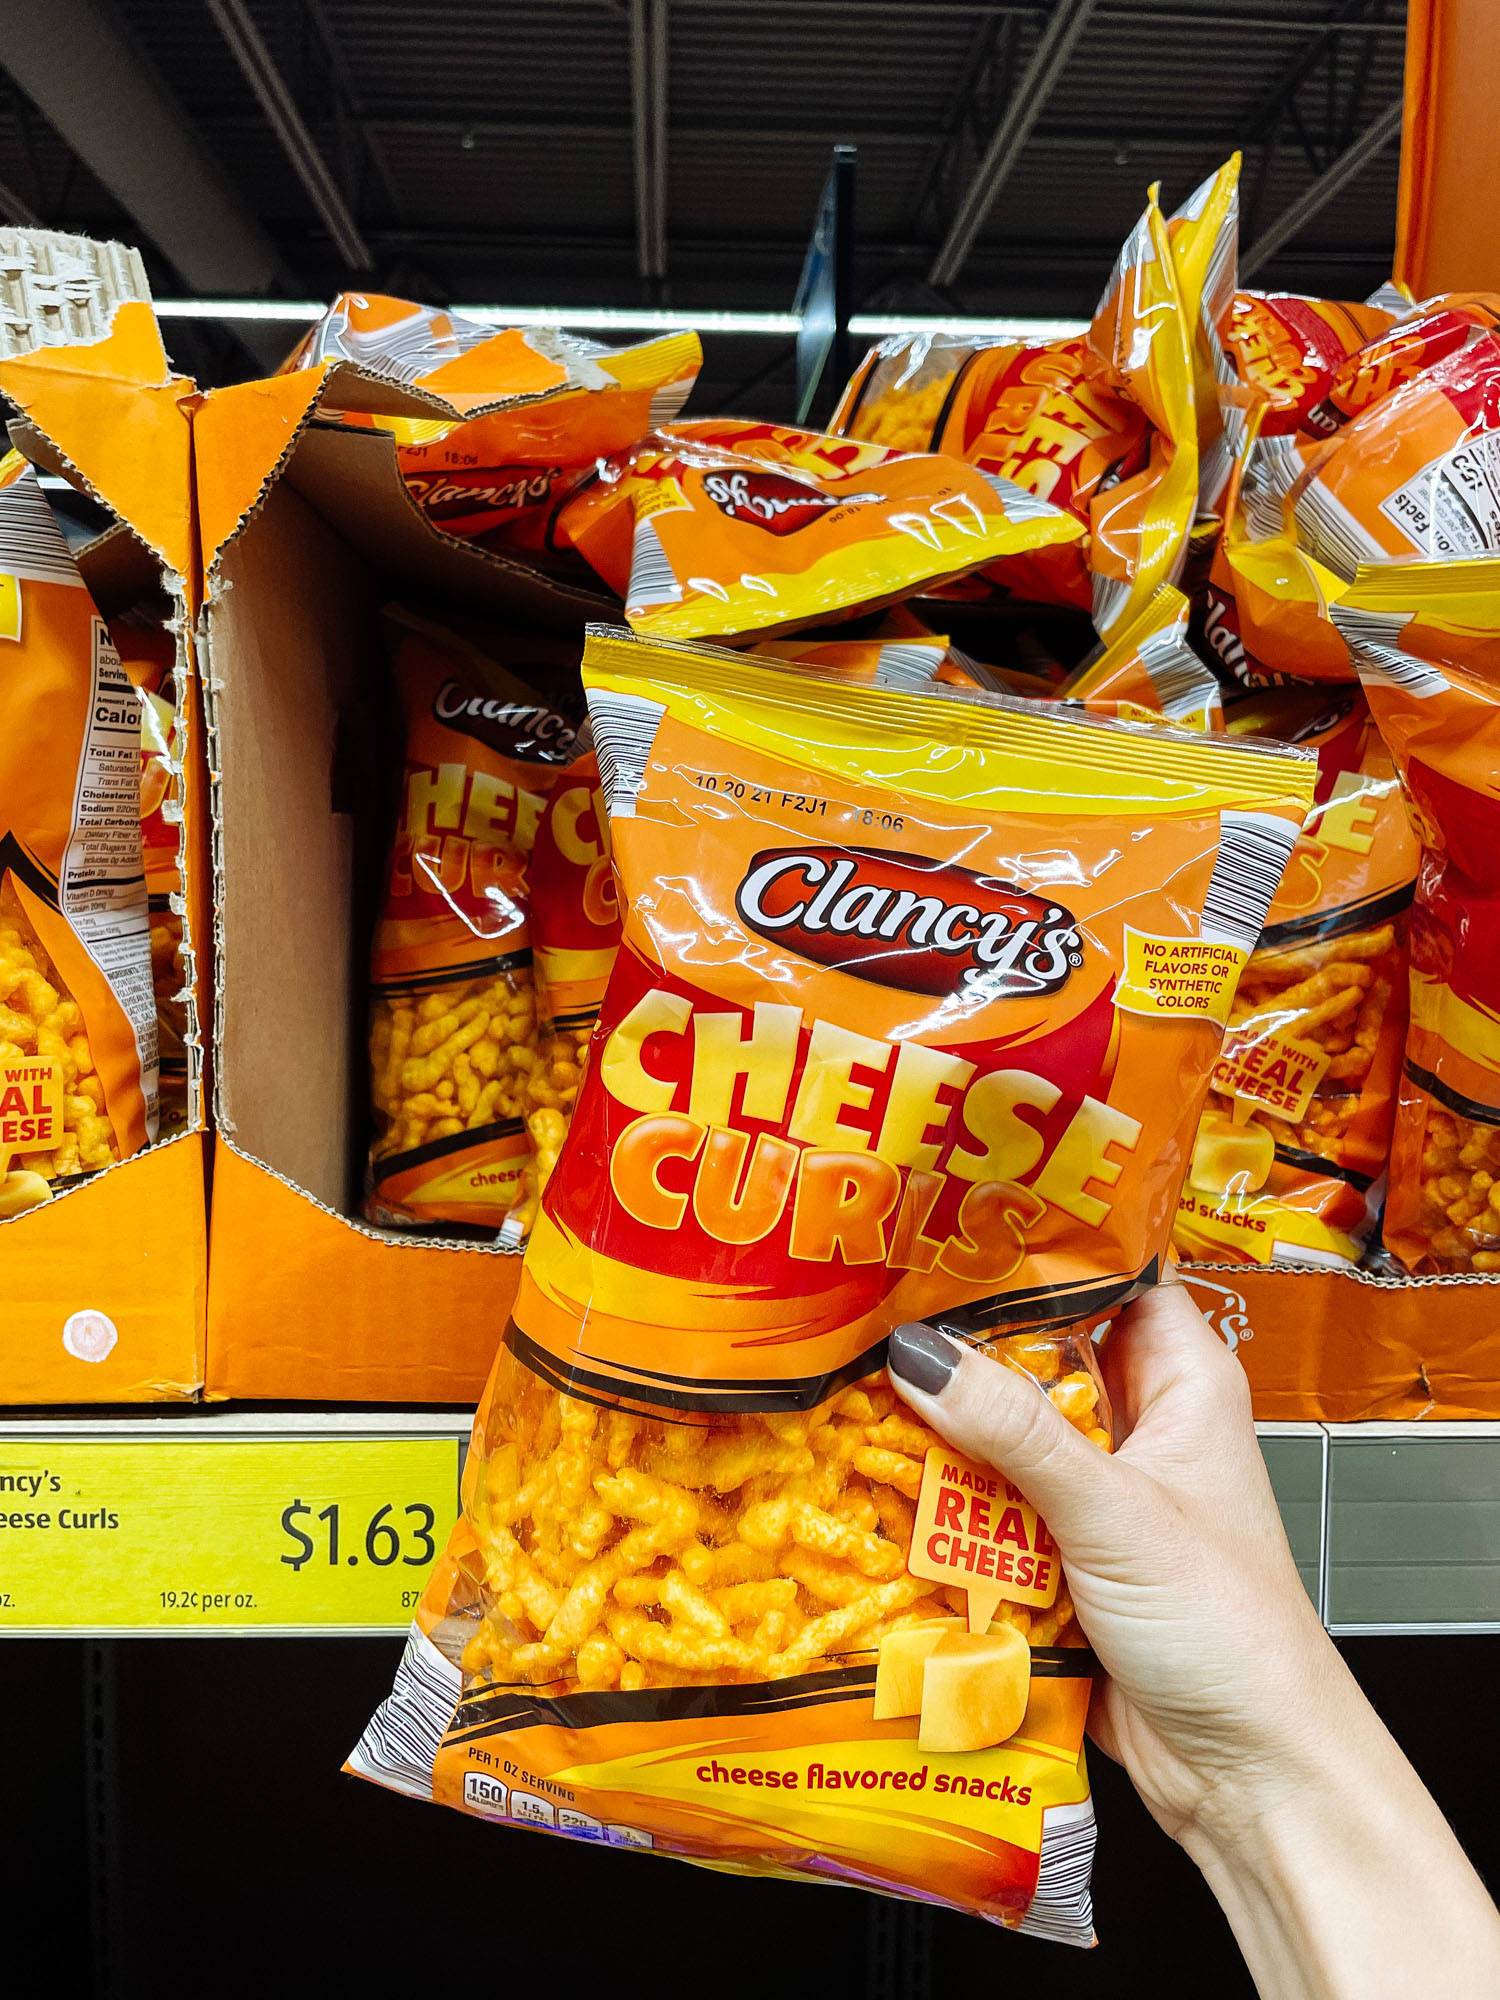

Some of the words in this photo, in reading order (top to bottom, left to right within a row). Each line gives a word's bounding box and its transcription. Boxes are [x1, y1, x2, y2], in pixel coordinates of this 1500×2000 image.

[1395, 494, 1430, 533] Facts
[90, 748, 115, 758] Total
[118, 750, 133, 759] Fat
[80, 804, 114, 813] Sodium
[83, 791, 136, 801] Cholesterol
[696, 776, 717, 791] 10
[724, 781, 745, 798] 20
[751, 788, 772, 804] 21
[781, 793, 827, 816] F2J1
[80, 818, 103, 827] Total
[68, 869, 96, 879] Protein
[739, 855, 1081, 985] Clancy's
[1144, 943, 1166, 957] NO
[1169, 946, 1239, 964] ARTIFICIAL
[1145, 960, 1208, 975] FLAVORS
[1211, 964, 1229, 978] OR
[1149, 978, 1222, 993] SYNTHETIC
[1156, 995, 1210, 1009] COLORS
[1223, 1038, 1304, 1095] REAL
[1281, 1045, 1319, 1071] WITH
[5, 1067, 52, 1082] WITH
[1213, 1062, 1300, 1112] CHEESE
[599, 987, 1144, 1230] CHEESE
[609, 1113, 1047, 1284] CURLS
[1200, 1203, 1267, 1233] snacks
[940, 1463, 998, 1498] MADE
[58, 1508, 119, 1529] Curls
[934, 1486, 1053, 1556] REAL
[280, 1499, 436, 1572] $1.63
[926, 1532, 1051, 1592] CHEESE
[160, 1592, 198, 1608] 19.2¢
[202, 1594, 230, 1612] per
[234, 1594, 258, 1608] oz.
[401, 1591, 422, 1608] 87
[468, 1746, 492, 1766] PER
[494, 1757, 500, 1769] 1
[503, 1760, 518, 1778] OZ
[521, 1771, 576, 1802] SERVING
[696, 1760, 799, 1790] cheese
[806, 1762, 929, 1792] flavored
[933, 1771, 1033, 1807] snacks
[469, 1777, 503, 1803] 150
